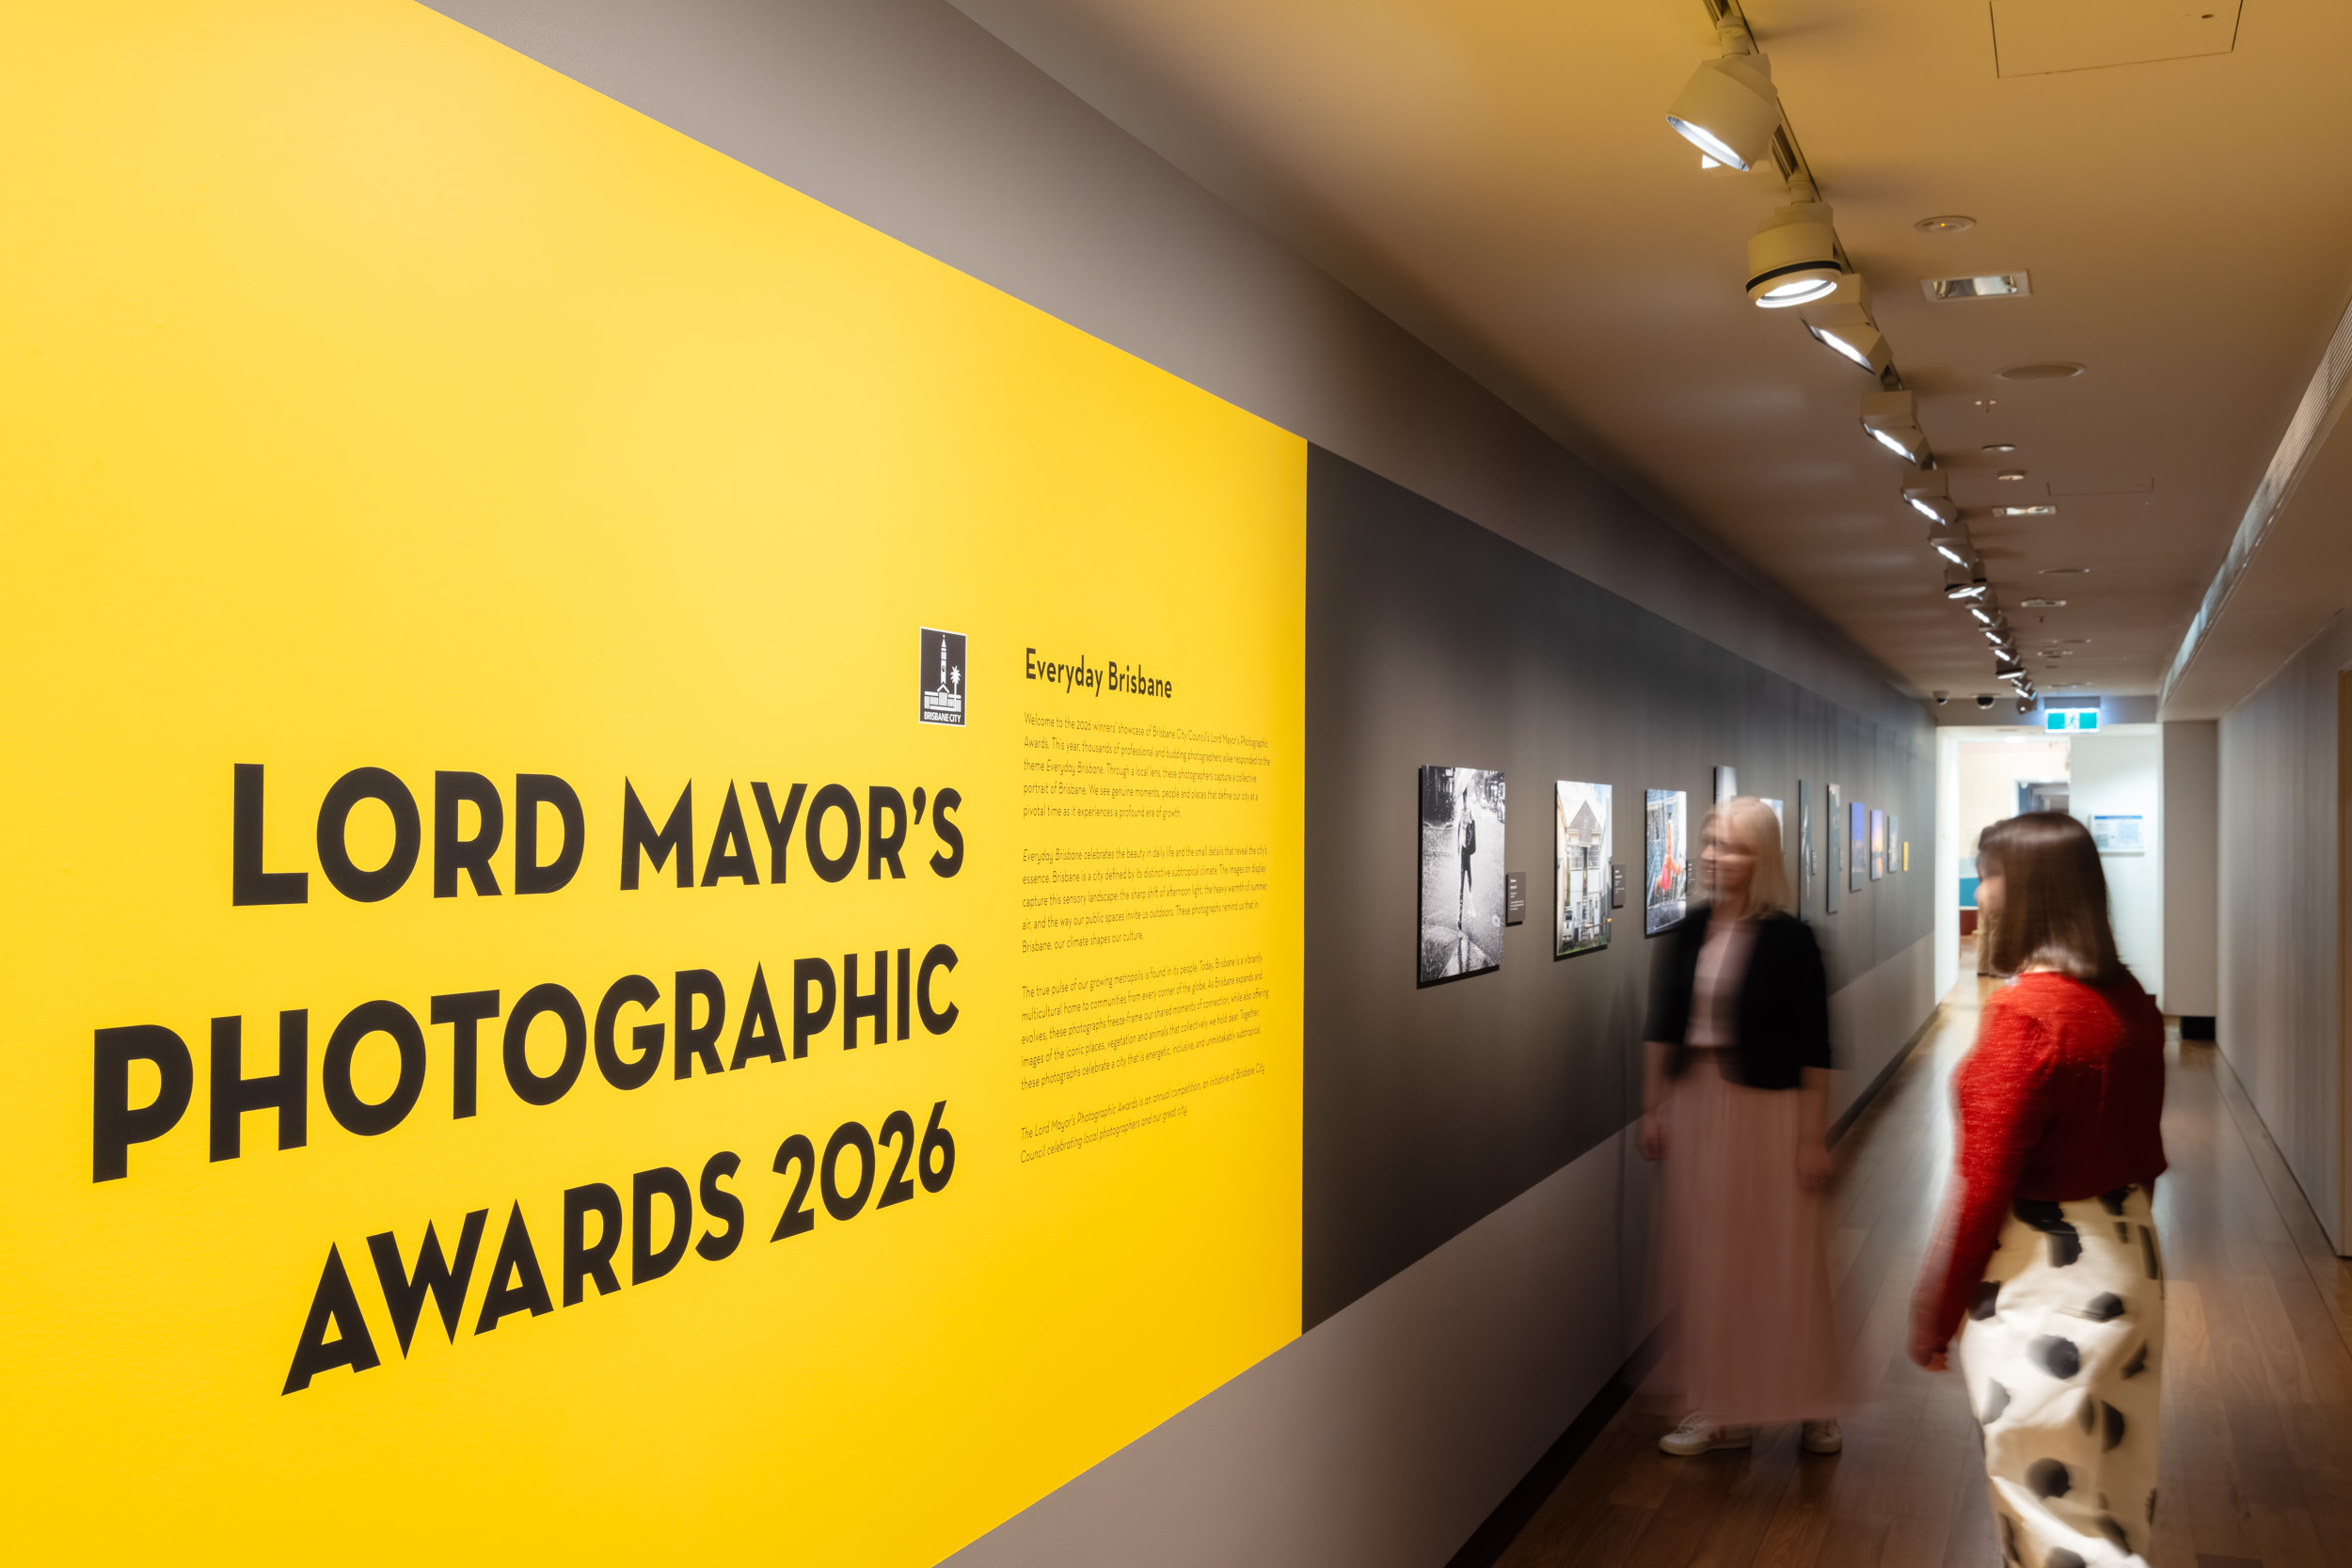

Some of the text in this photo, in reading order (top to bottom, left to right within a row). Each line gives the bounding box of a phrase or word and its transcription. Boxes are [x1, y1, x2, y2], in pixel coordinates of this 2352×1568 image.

[1026, 647, 1172, 698] Everyday Brisbane
[924, 711, 961, 723] BRISBANE CITY
[1024, 712, 1055, 727] Welcome
[1056, 717, 1063, 728] to
[1064, 716, 1075, 729] the
[1076, 720, 1092, 731] 2026
[1092, 722, 1117, 733] winners'
[1024, 736, 1050, 749] Awards.
[1051, 736, 1065, 750] This
[1066, 742, 1081, 754] year,
[1082, 739, 1112, 754] thousands
[1113, 741, 1120, 754] of
[1023, 758, 1045, 771] theme
[1046, 758, 1076, 777] Everyday
[1077, 760, 1105, 775] Brisbane.
[1023, 782, 1049, 796] portrait
[1050, 780, 1057, 794] of
[1058, 781, 1087, 795] Brisbane.
[1088, 784, 1099, 796] We
[1100, 787, 1110, 796] see
[1023, 803, 1046, 819] pivotal
[1047, 805, 1062, 816] time
[1062, 808, 1070, 816] as
[1071, 805, 1076, 817] it
[1077, 805, 1113, 819] experiences
[1114, 809, 1118, 817] a
[233, 764, 963, 906] LORD MAYOR'S
[1023, 848, 1054, 865] Everyday
[1055, 847, 1082, 861] Brisbane
[1083, 847, 1114, 860] celebrates
[1115, 847, 1126, 859] the
[1022, 875, 1051, 885] essence.
[1052, 870, 1080, 883] Brisbane
[1081, 870, 1086, 882] is
[1087, 873, 1091, 881] a
[1092, 869, 1104, 884] city
[1105, 867, 1127, 880] defined
[1022, 895, 1048, 910] capture
[1049, 892, 1062, 906] this
[1062, 895, 1086, 906] sensory
[1088, 890, 1119, 904] landscape:
[1022, 918, 1032, 931] air,
[1033, 915, 1046, 929] and
[1047, 915, 1058, 928] the
[1059, 918, 1072, 929] way
[1073, 916, 1084, 925] our
[1085, 911, 1104, 927] public
[1105, 913, 1125, 925] spaces
[1022, 939, 1053, 953] Brisbane,
[1054, 940, 1065, 950] our
[1066, 935, 1089, 948] climate
[1090, 933, 1111, 946] shapes
[1111, 934, 1122, 943] our
[1021, 985, 1035, 998] The
[1036, 985, 1050, 997] true
[1051, 980, 1069, 997] pulse
[1070, 977, 1077, 991] of
[1077, 980, 1089, 990] our
[1089, 975, 1113, 992] growing
[1021, 1002, 1062, 1021] multicultural
[1063, 1001, 1081, 1014] home
[1082, 1000, 1089, 1011] to
[1090, 994, 1127, 1010] communities
[1021, 1029, 1048, 1045] evolves,
[1049, 1026, 1067, 1039] these
[1068, 1017, 1106, 1039] photographs
[93, 944, 959, 1183] PHOTOGRAPHIC
[1021, 1054, 1044, 1069] images
[1045, 1047, 1053, 1063] of
[1054, 1047, 1065, 1061] the
[1066, 1043, 1084, 1057] iconic
[1085, 1040, 1106, 1056] places,
[1021, 1077, 1040, 1090] these
[1041, 1066, 1081, 1088] photographs
[1082, 1060, 1110, 1076] celebrate
[1111, 1060, 1115, 1069] a
[1116, 1055, 1127, 1069] city
[1021, 1127, 1033, 1140] The
[1034, 1120, 1050, 1137] Lord
[1050, 1114, 1076, 1133] Mayor's
[1076, 1104, 1116, 1124] Photographic
[1020, 1143, 1046, 1163] Council
[1046, 1137, 1083, 1156] celebrating
[1083, 1128, 1099, 1144] local
[281, 1101, 955, 1396] AWARDS 2026
